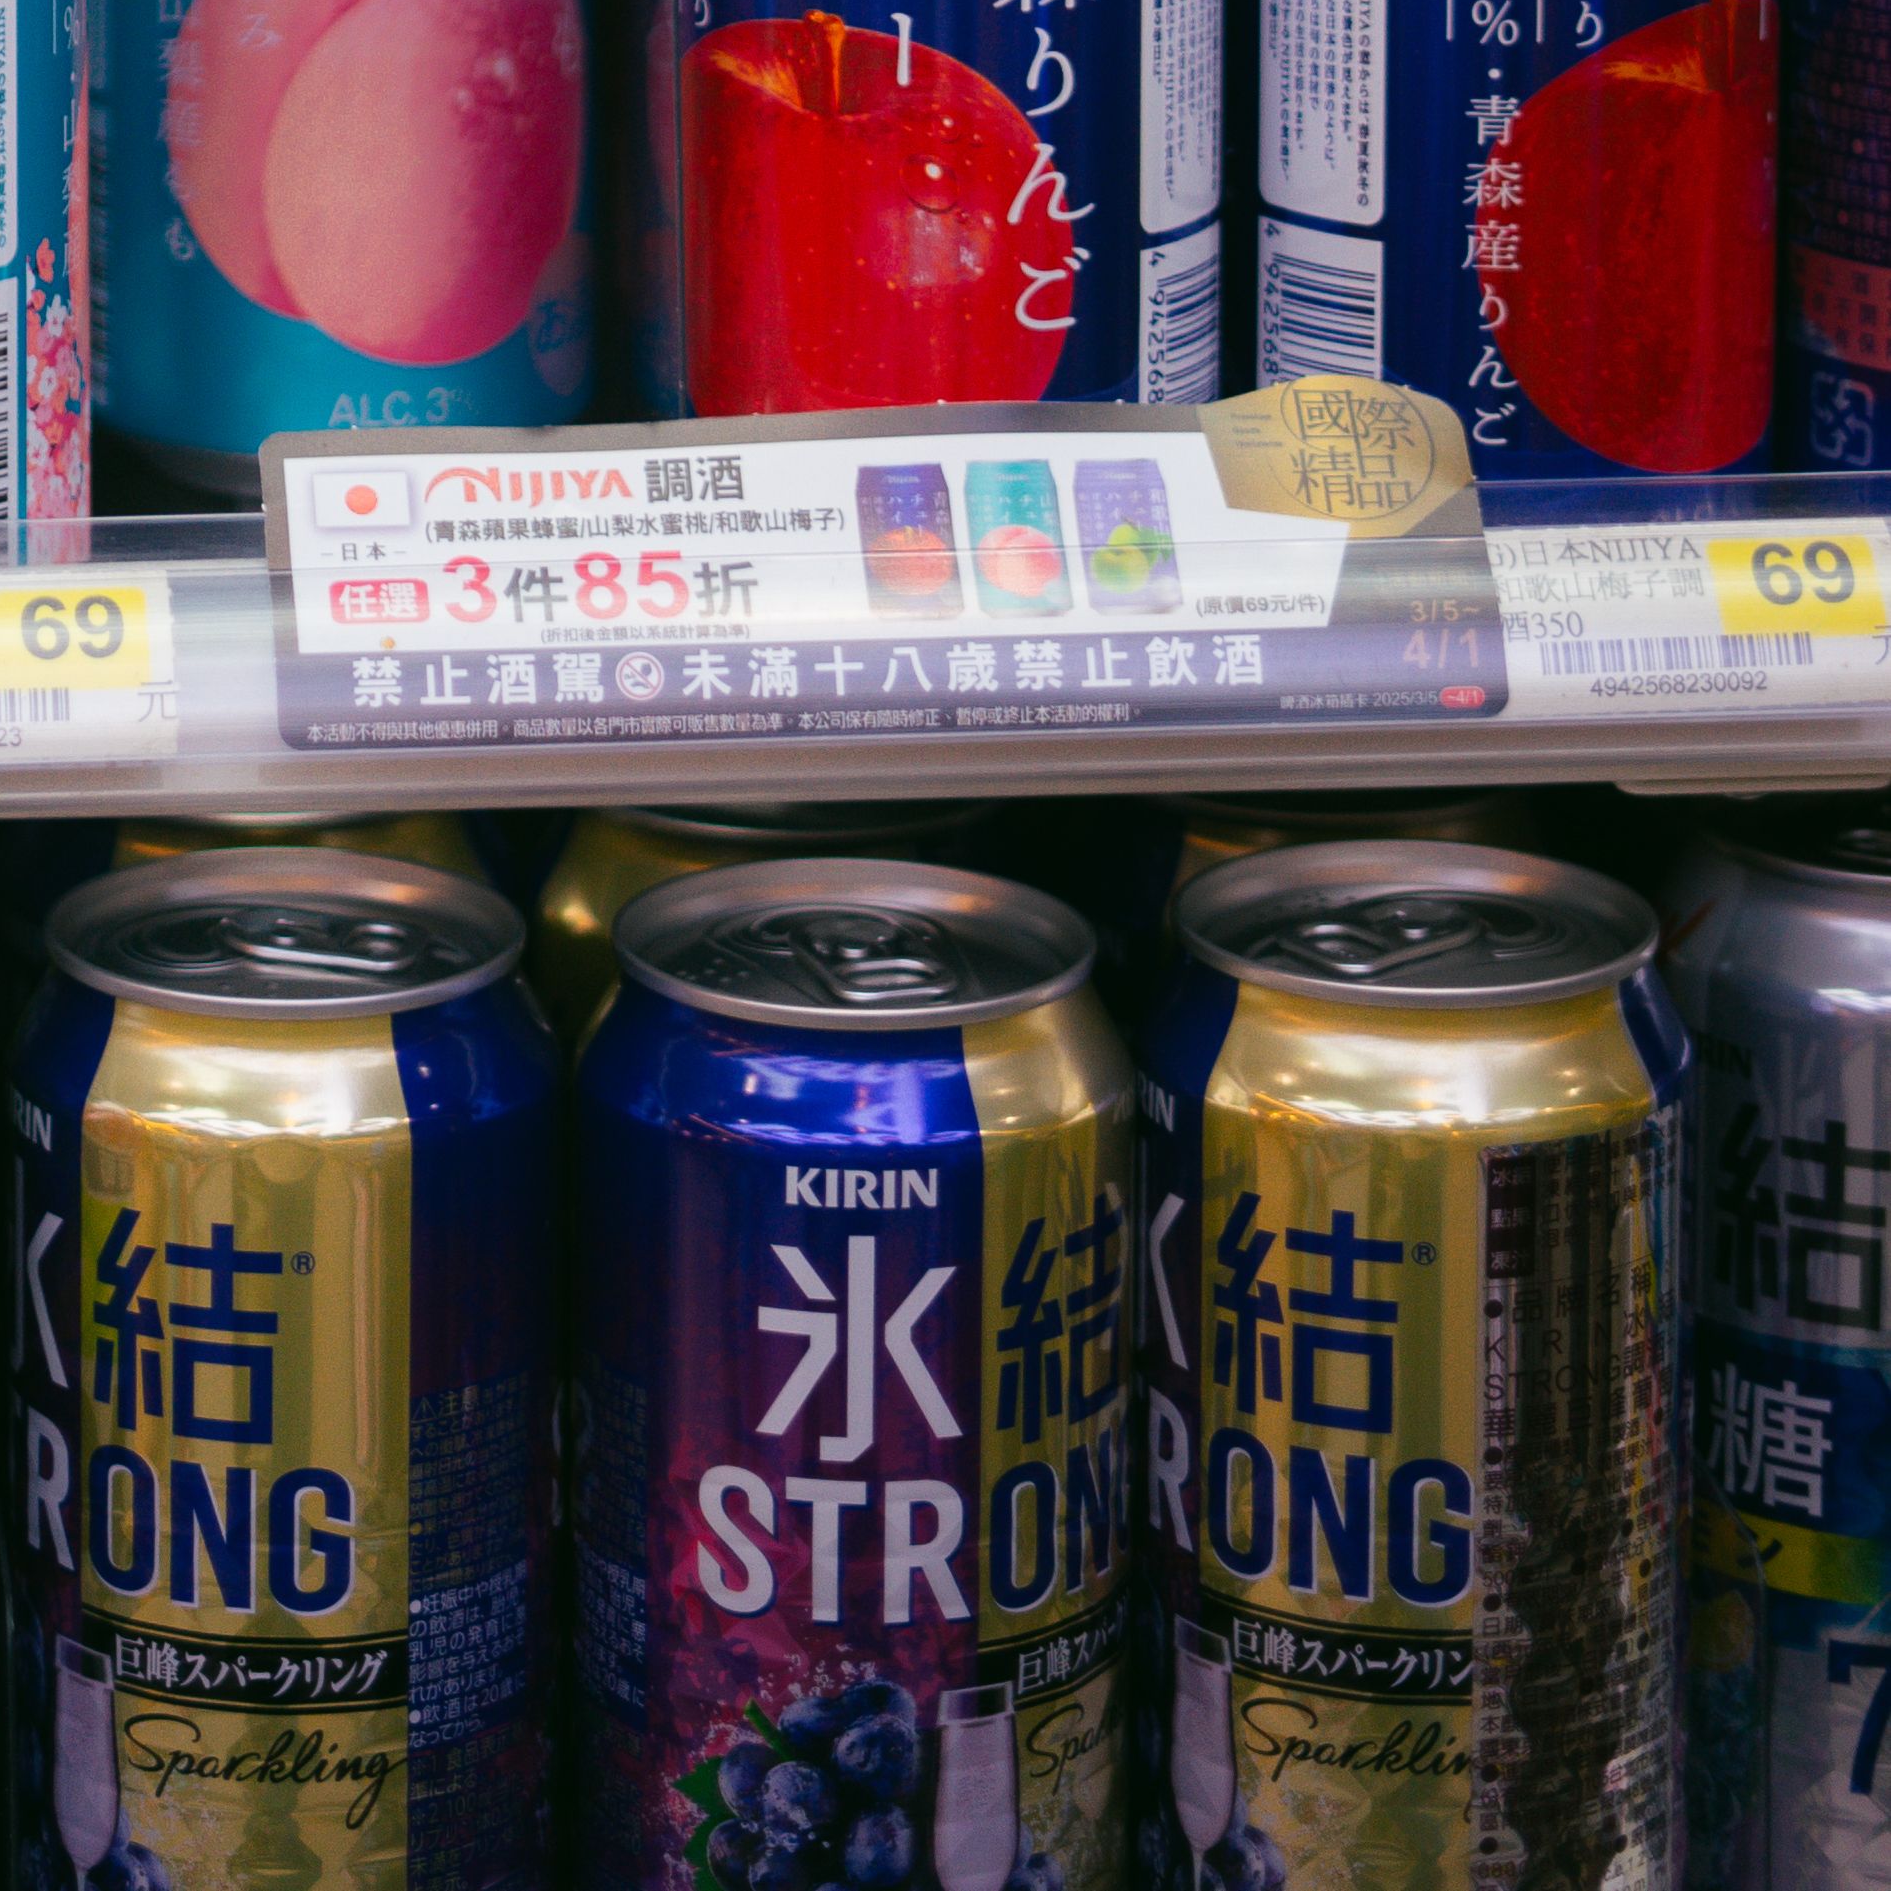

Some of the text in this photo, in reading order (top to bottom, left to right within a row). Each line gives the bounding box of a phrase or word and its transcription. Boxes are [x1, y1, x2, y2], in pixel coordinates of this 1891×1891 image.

[423, 454, 746, 509] NIJIYA 調酒
[339, 541, 389, 562] 日本
[1749, 540, 1857, 607] 69
[338, 582, 421, 620] 任選
[441, 549, 760, 624] 3件85折
[1194, 592, 1327, 619] (原價69元/件)
[19, 593, 125, 661] 69
[1402, 628, 1482, 671] 4/1
[352, 631, 1266, 709] 禁止酒駕 未滿十八歲禁止飲酒
[1589, 670, 1769, 699] 4942568230092
[1372, 690, 1439, 709] 2025/3/5
[785, 1163, 940, 1210] KIRIN
[1708, 1360, 1836, 1520] 糖
[112, 1630, 391, 1702] 巨峰スパークリング
[121, 1712, 412, 1833] Sparkling
